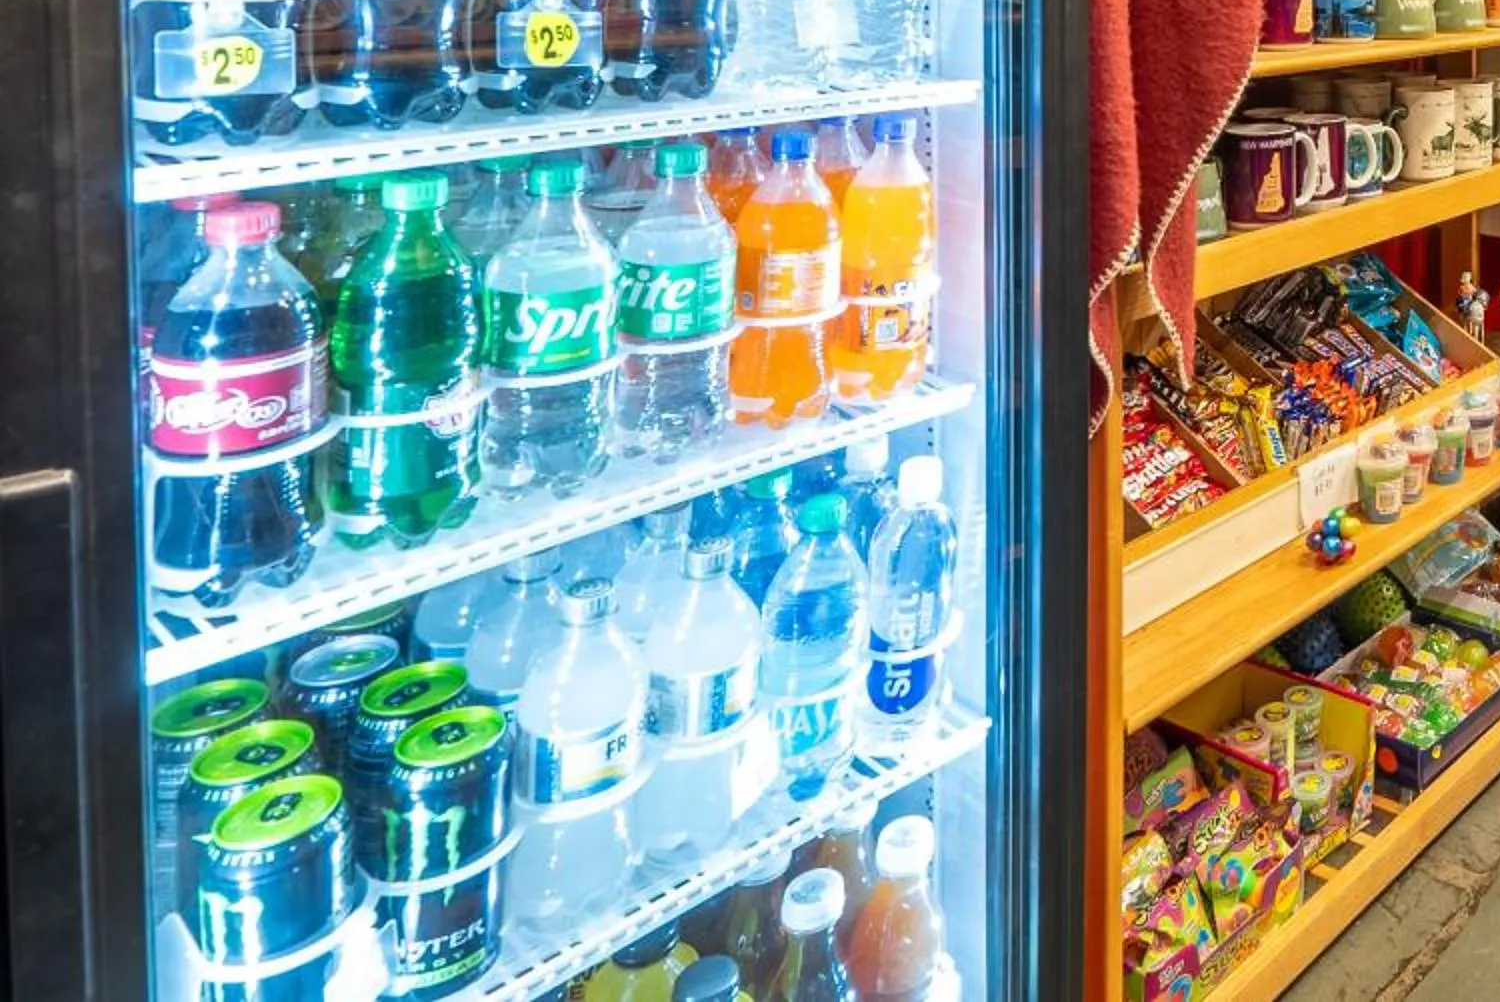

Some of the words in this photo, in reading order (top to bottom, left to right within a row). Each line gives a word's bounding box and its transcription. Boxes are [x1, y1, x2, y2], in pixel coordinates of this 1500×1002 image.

[615, 266, 698, 310] rite
[504, 297, 617, 354] Spri
[1123, 448, 1193, 500] Skittles
